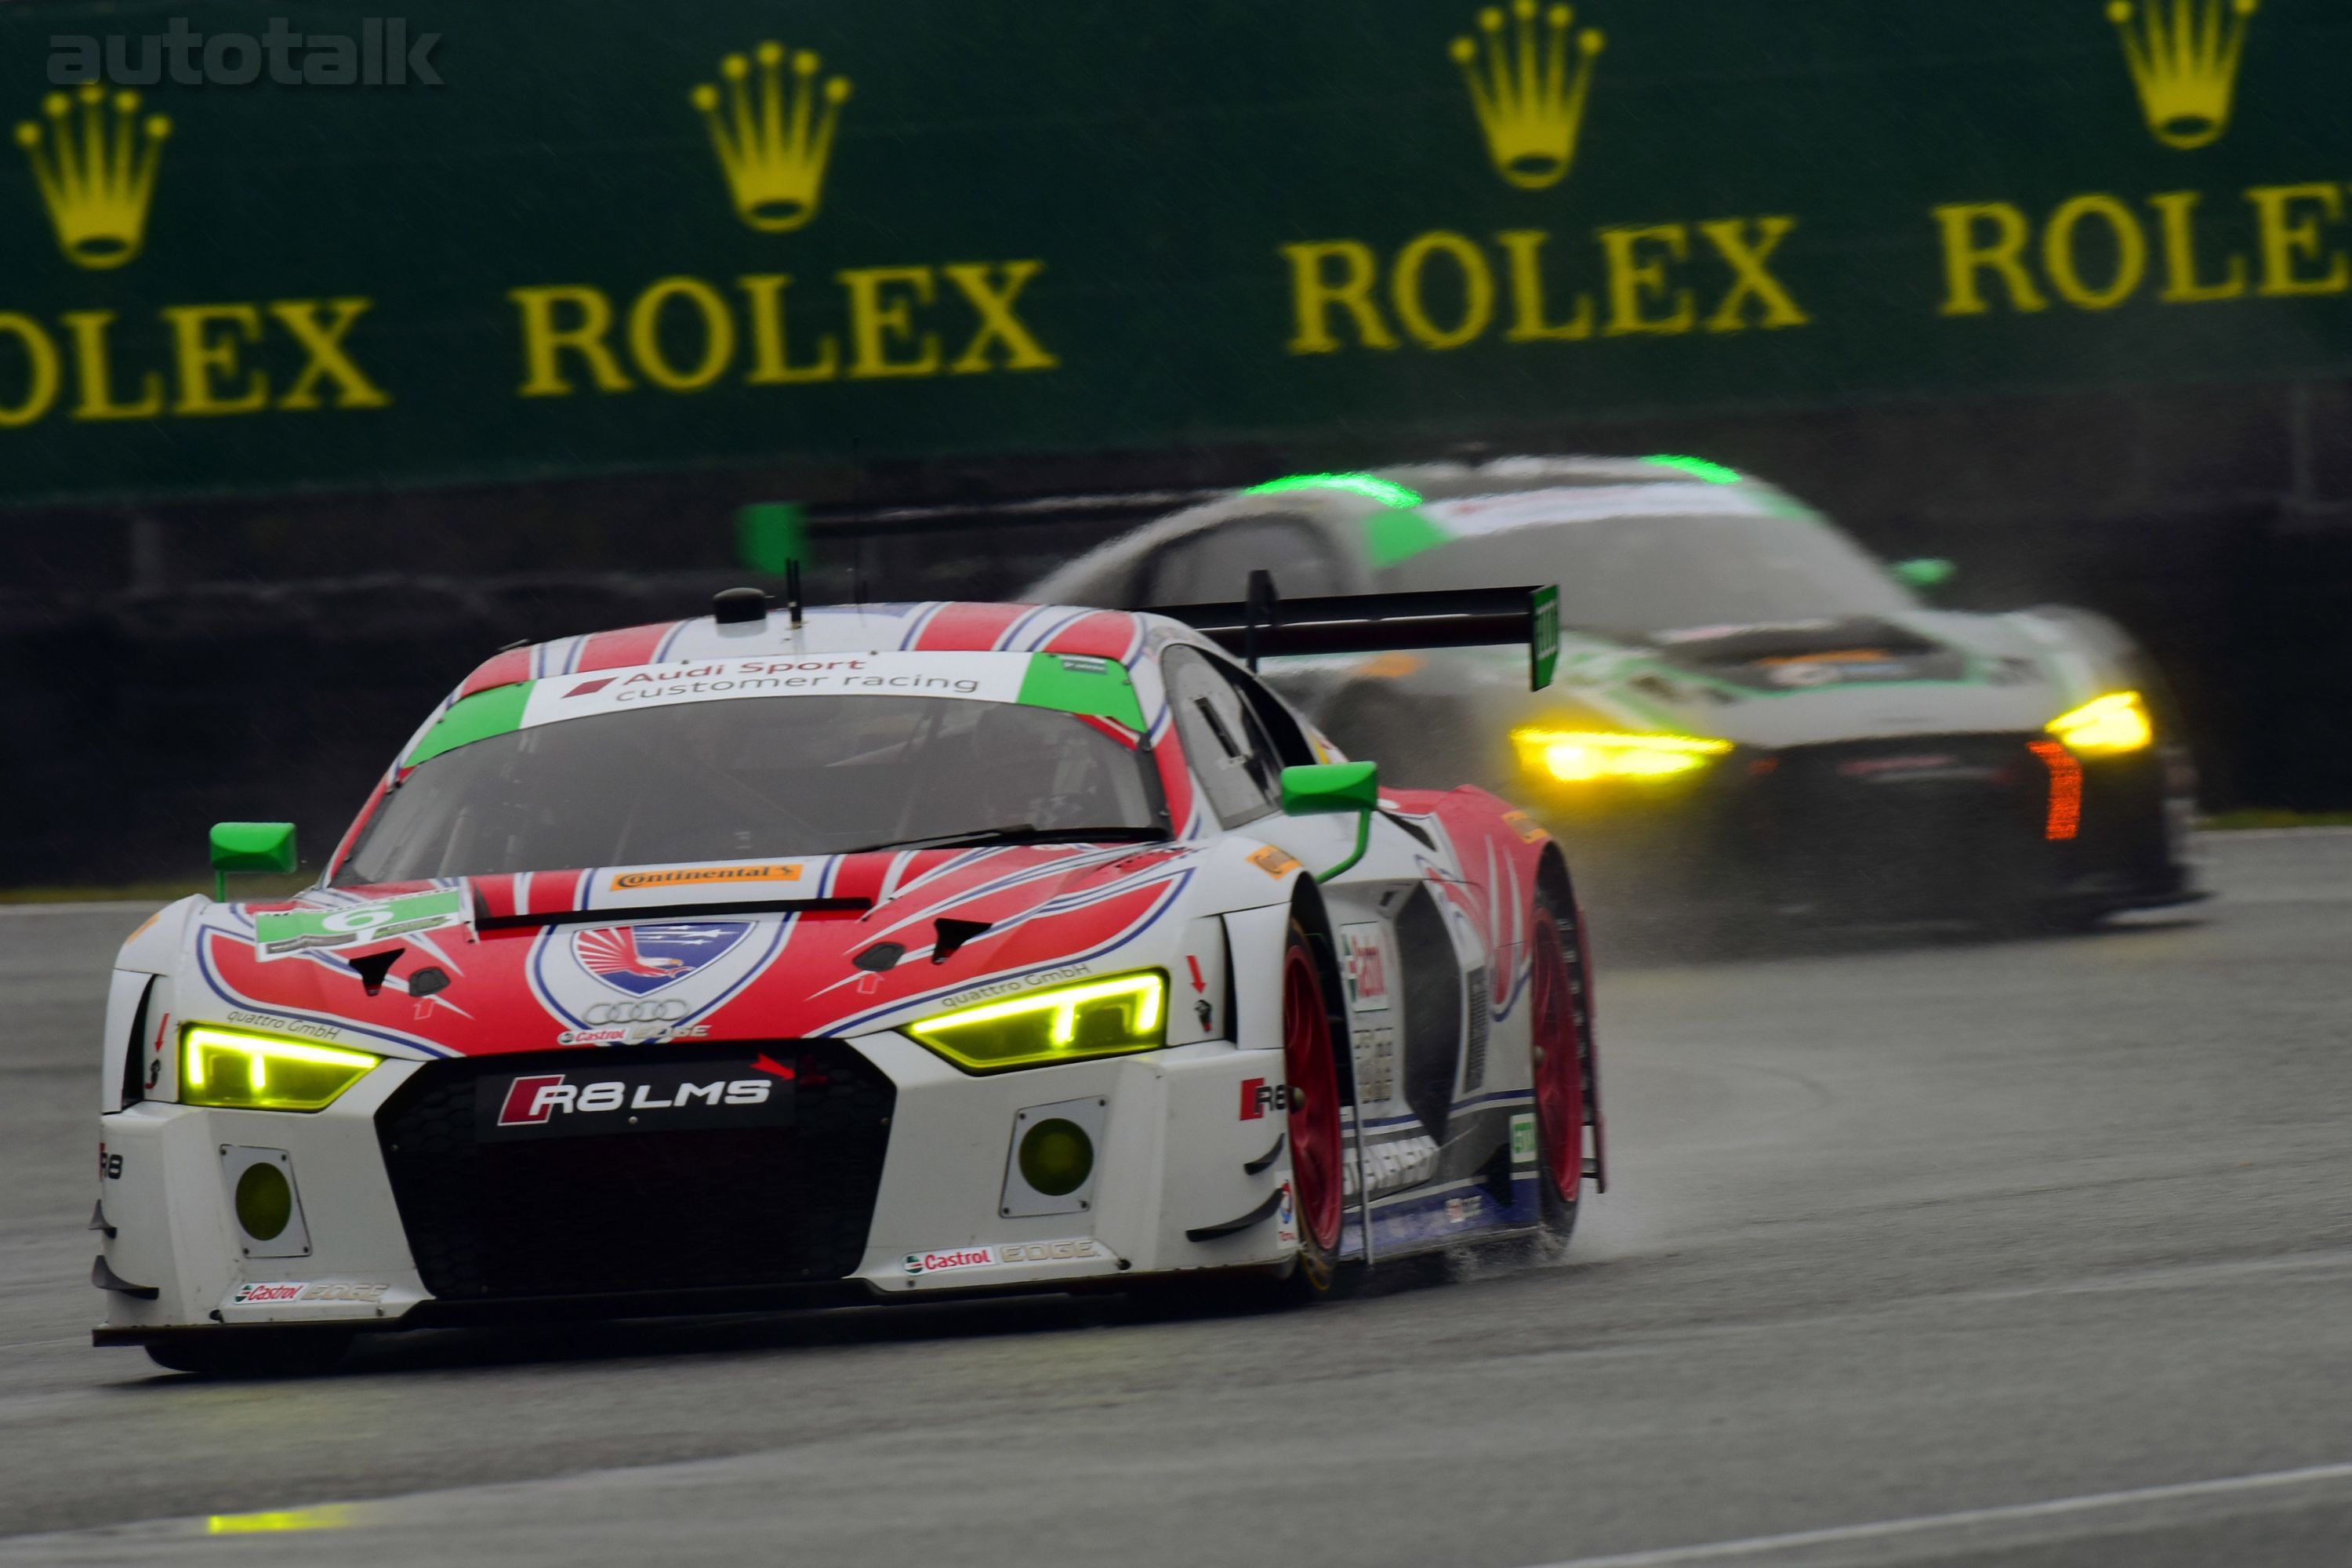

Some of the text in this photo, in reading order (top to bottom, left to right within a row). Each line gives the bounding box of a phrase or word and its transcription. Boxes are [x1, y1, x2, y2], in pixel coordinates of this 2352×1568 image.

[1930, 181, 2352, 316] ROLE
[1279, 216, 1810, 356] ROLEX
[508, 259, 1060, 396] ROLEX
[622, 658, 866, 685] Audi Sport
[615, 673, 980, 702] customer racing
[618, 866, 770, 887] Continental
[321, 905, 394, 931] 6
[942, 964, 1091, 1007] quattro GmbH
[227, 1011, 342, 1040] quattro GmbH
[575, 1029, 625, 1042] Castrol
[528, 1080, 772, 1116] R8 LMS
[1254, 1084, 1288, 1112] R8
[924, 1240, 1102, 1271] Castrol EDGE
[248, 1285, 303, 1301] Castrol
